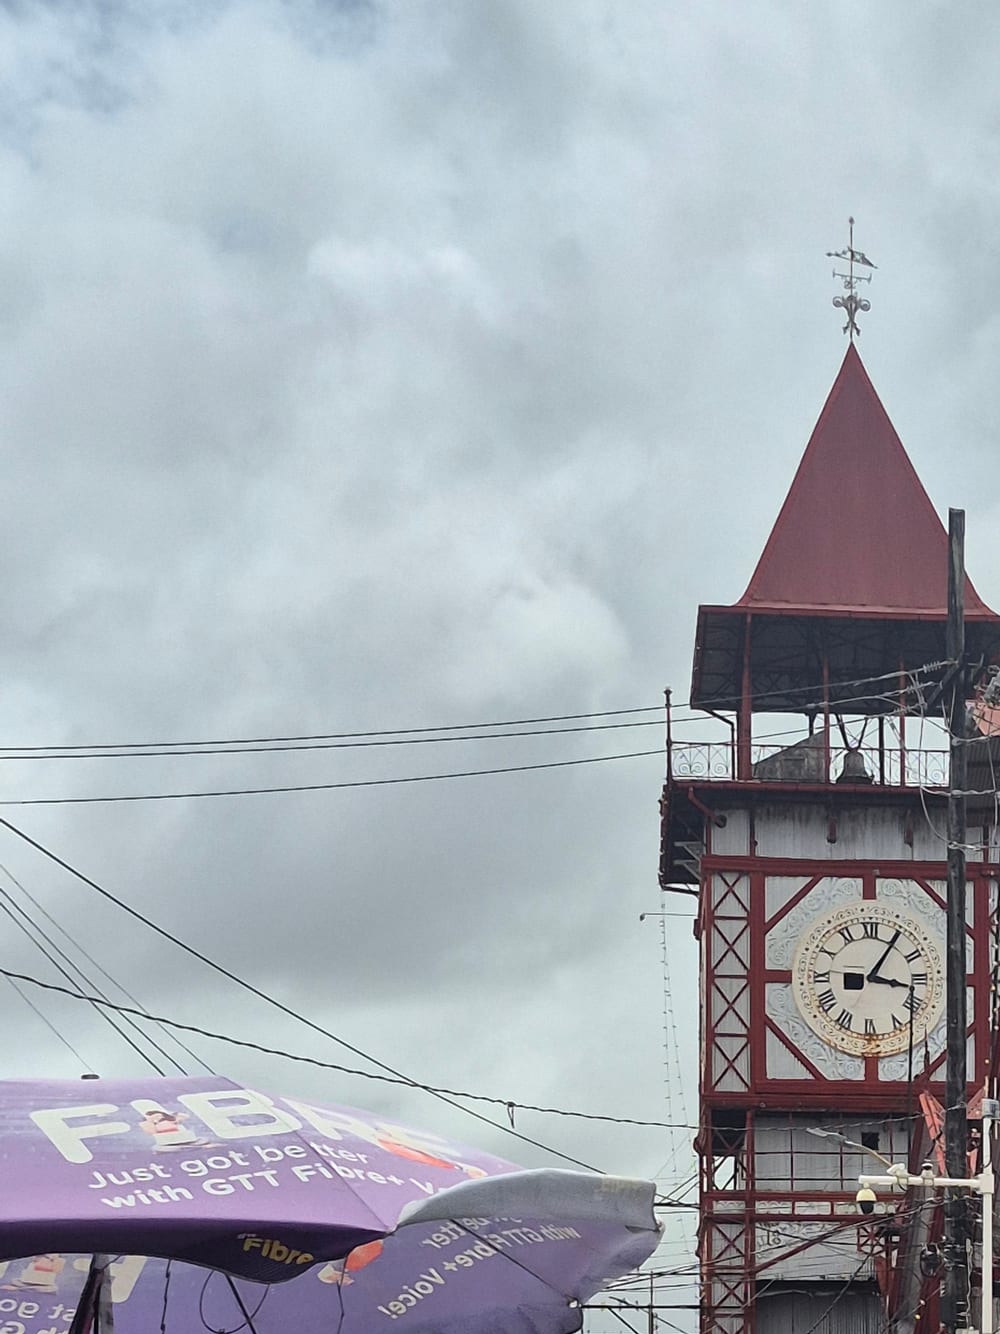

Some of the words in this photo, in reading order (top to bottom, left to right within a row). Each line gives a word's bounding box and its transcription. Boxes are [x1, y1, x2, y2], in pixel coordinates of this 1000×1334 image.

[88, 1163, 172, 1188] Just
[180, 1150, 250, 1177] got
[253, 1142, 369, 1164] better
[101, 1185, 194, 1208] with
[201, 1169, 280, 1195] GTT
[291, 1162, 405, 1186] Fibre+
[243, 1238, 315, 1265] Fibre
